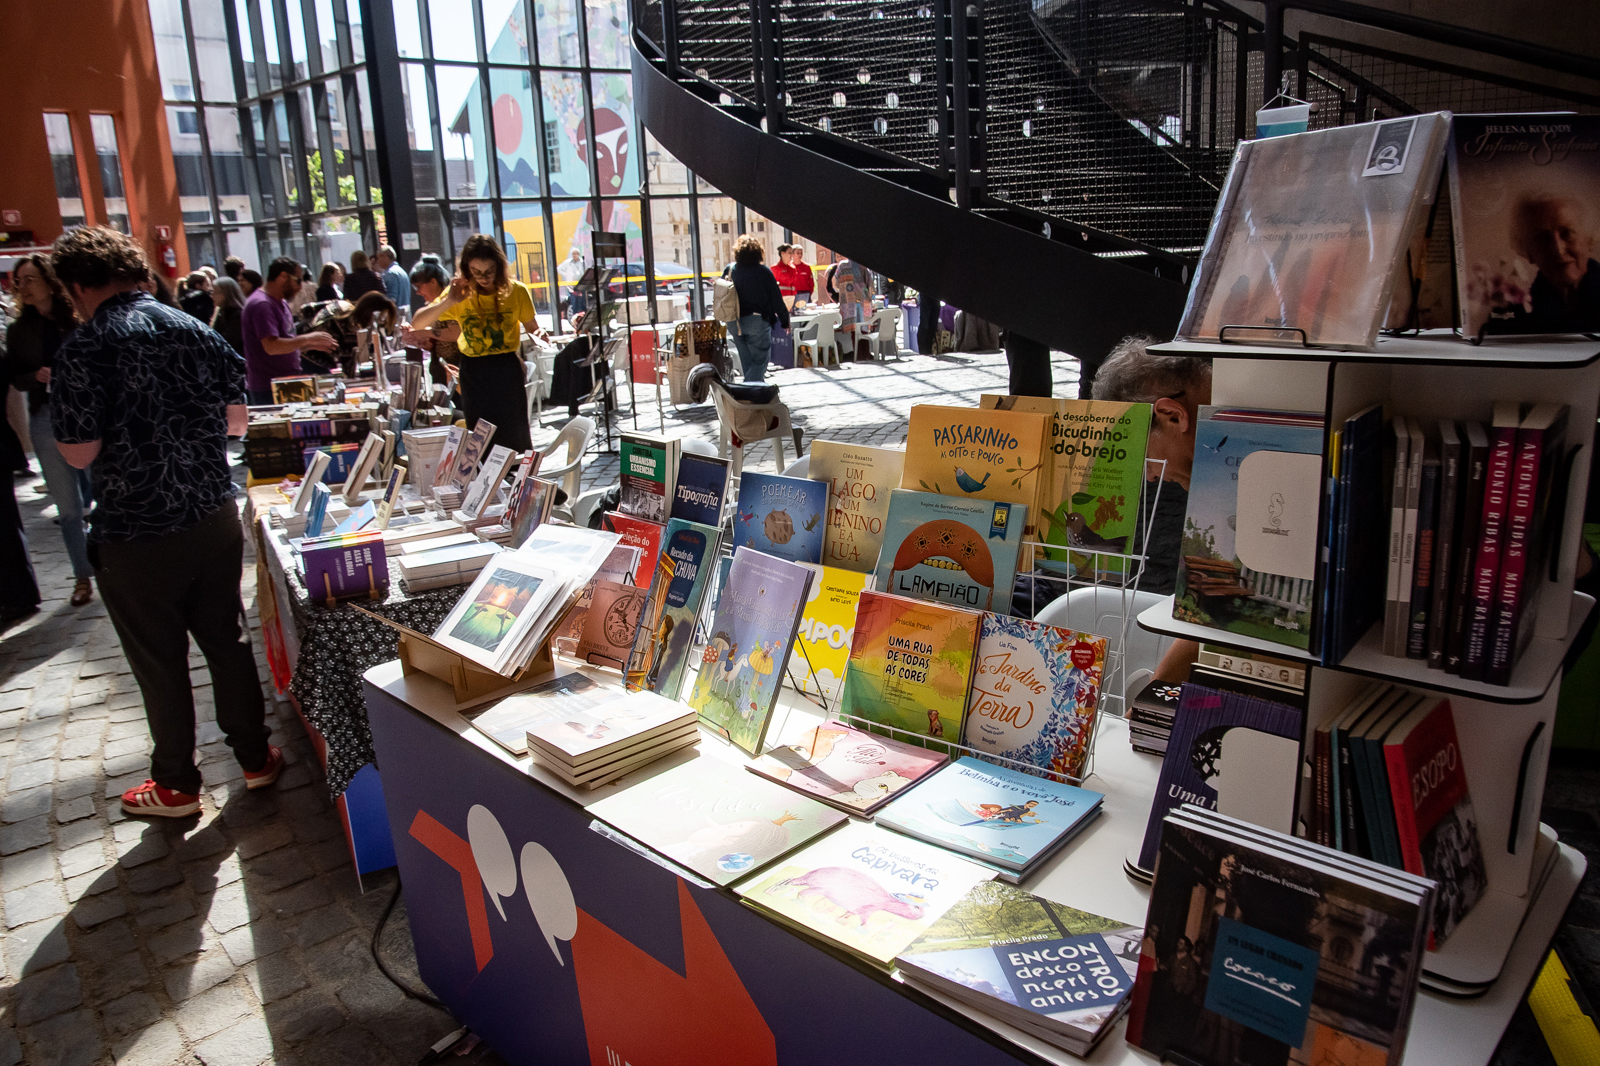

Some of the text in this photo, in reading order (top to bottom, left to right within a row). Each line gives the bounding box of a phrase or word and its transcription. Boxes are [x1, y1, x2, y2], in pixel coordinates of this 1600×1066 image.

[1485, 124, 1572, 134] HELENA KOLODY
[1464, 131, 1598, 165] Infinita Sinfonia
[1053, 411, 1131, 425] A descoberta do
[933, 424, 1018, 450] PASSARINHO
[1051, 422, 1128, 442] Bicudinho-
[629, 454, 657, 468] URBANISMO
[948, 446, 968, 458] OITO
[970, 450, 976, 459] E
[977, 448, 1004, 466] POUCO
[1050, 439, 1127, 463] -do-brejo
[630, 463, 655, 476] ESSENCIAL
[846, 467, 864, 480] UM
[677, 484, 719, 508] Tipografia
[761, 483, 807, 505] POEMEAR
[830, 477, 877, 503] LAGO,
[843, 499, 860, 511] UM
[839, 530, 854, 542] E A
[1473, 439, 1511, 621] ANTONIO RIBAS MAHY-RA
[1498, 442, 1537, 626] ANTONIO RIBAS MAHY-RA
[641, 537, 650, 546] do
[829, 541, 861, 562] LUA
[343, 550, 355, 577] MELODIAS
[353, 549, 363, 562] ASAS
[362, 547, 372, 564] SOBRE
[670, 546, 694, 562] Recado da
[1416, 529, 1434, 587] BELOWARS
[674, 560, 698, 581] CHUVA
[846, 588, 859, 596] SOUZA
[899, 574, 980, 605] LAMPIÃO
[895, 617, 933, 631] Priscila Prado
[888, 635, 933, 655] UMA RUA
[887, 650, 930, 670] DE TODAS
[885, 664, 927, 684] AS CORES
[984, 652, 1047, 695] Jardins
[994, 676, 1012, 693] da
[969, 685, 1034, 729] Terra
[1008, 778, 1037, 791] aventuras
[1412, 742, 1457, 811] ESOPO
[1045, 793, 1076, 807] José
[1168, 783, 1207, 806] Uma
[851, 846, 940, 891] Capivara
[1239, 864, 1321, 898] José Carlos Fernandes
[988, 933, 1049, 947] Priscila Prado
[1015, 962, 1081, 979] desco
[1022, 973, 1088, 994] ncert
[1030, 988, 1100, 1008] antes
